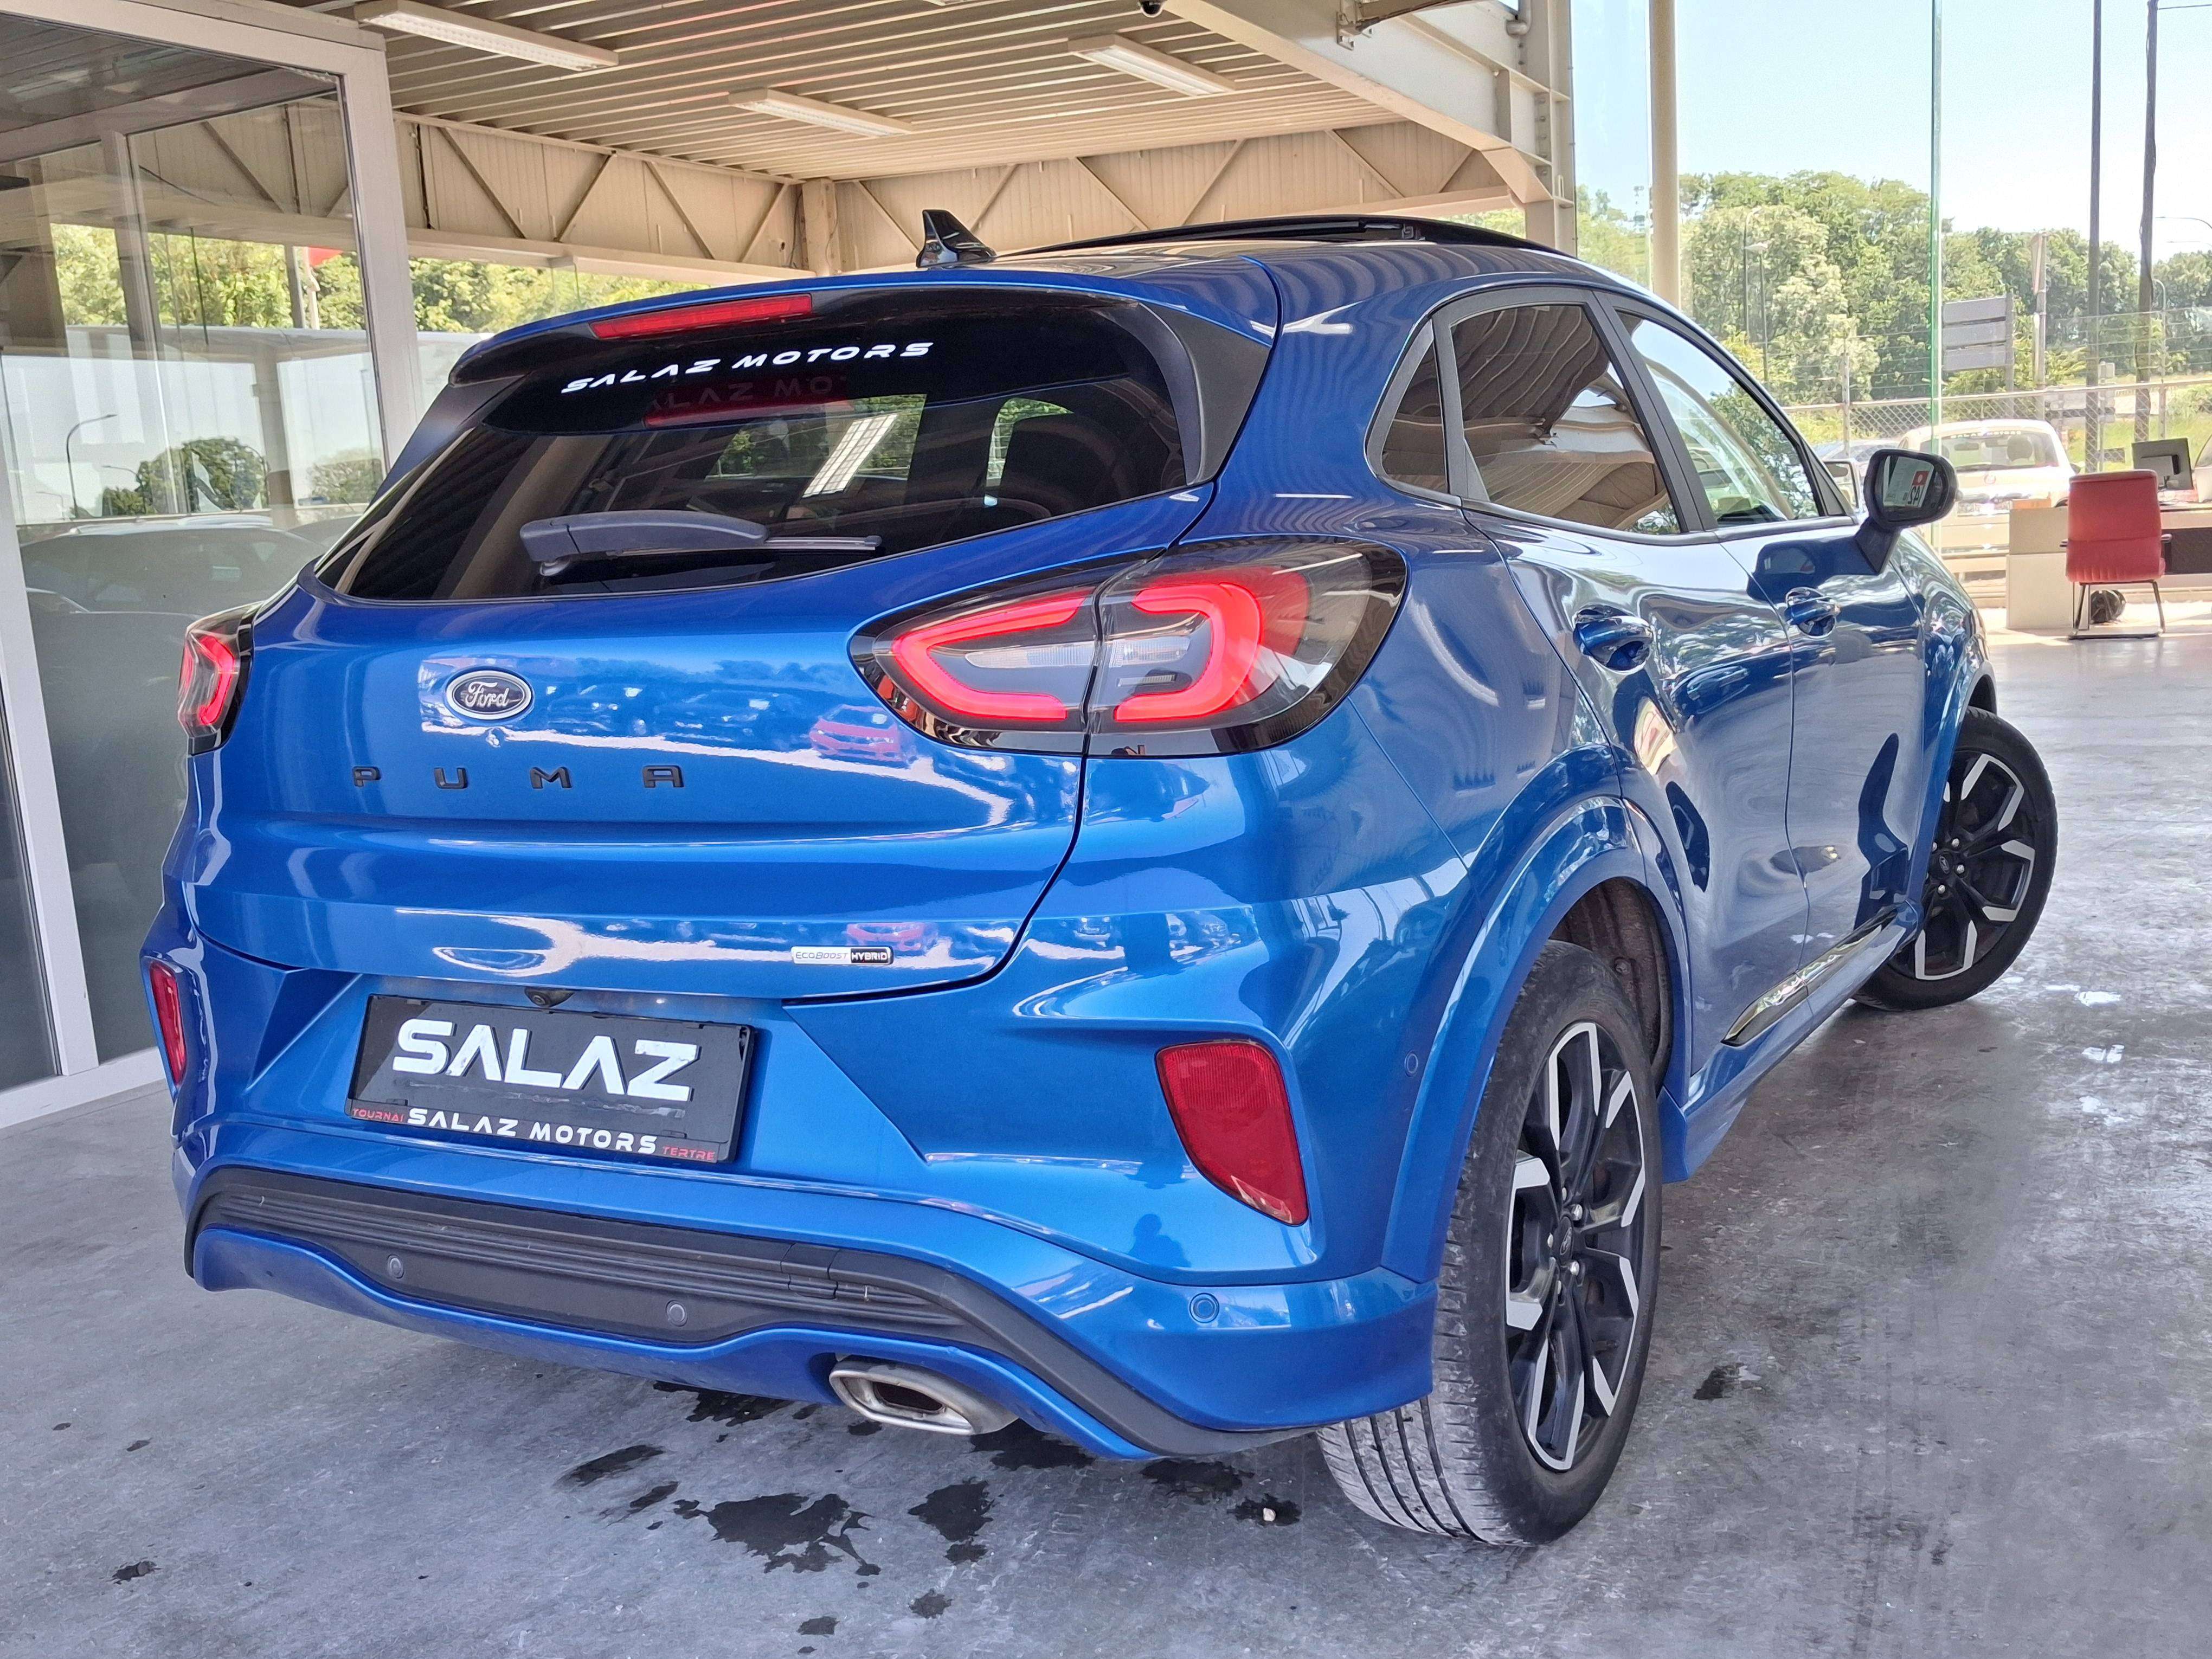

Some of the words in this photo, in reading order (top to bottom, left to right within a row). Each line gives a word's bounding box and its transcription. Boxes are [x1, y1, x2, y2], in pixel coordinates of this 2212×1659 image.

[562, 359, 721, 394] SALAZ
[731, 342, 934, 369] MOTORS
[464, 681, 510, 708] Ford
[352, 764, 685, 789] PUMA
[852, 952, 888, 961] HYBRID
[392, 1018, 698, 1102] SALAZ
[352, 1108, 404, 1123] TOURNAI
[407, 1108, 518, 1137] SALAZ
[528, 1122, 658, 1155] MOTORS
[661, 1146, 715, 1161] TERTRE
